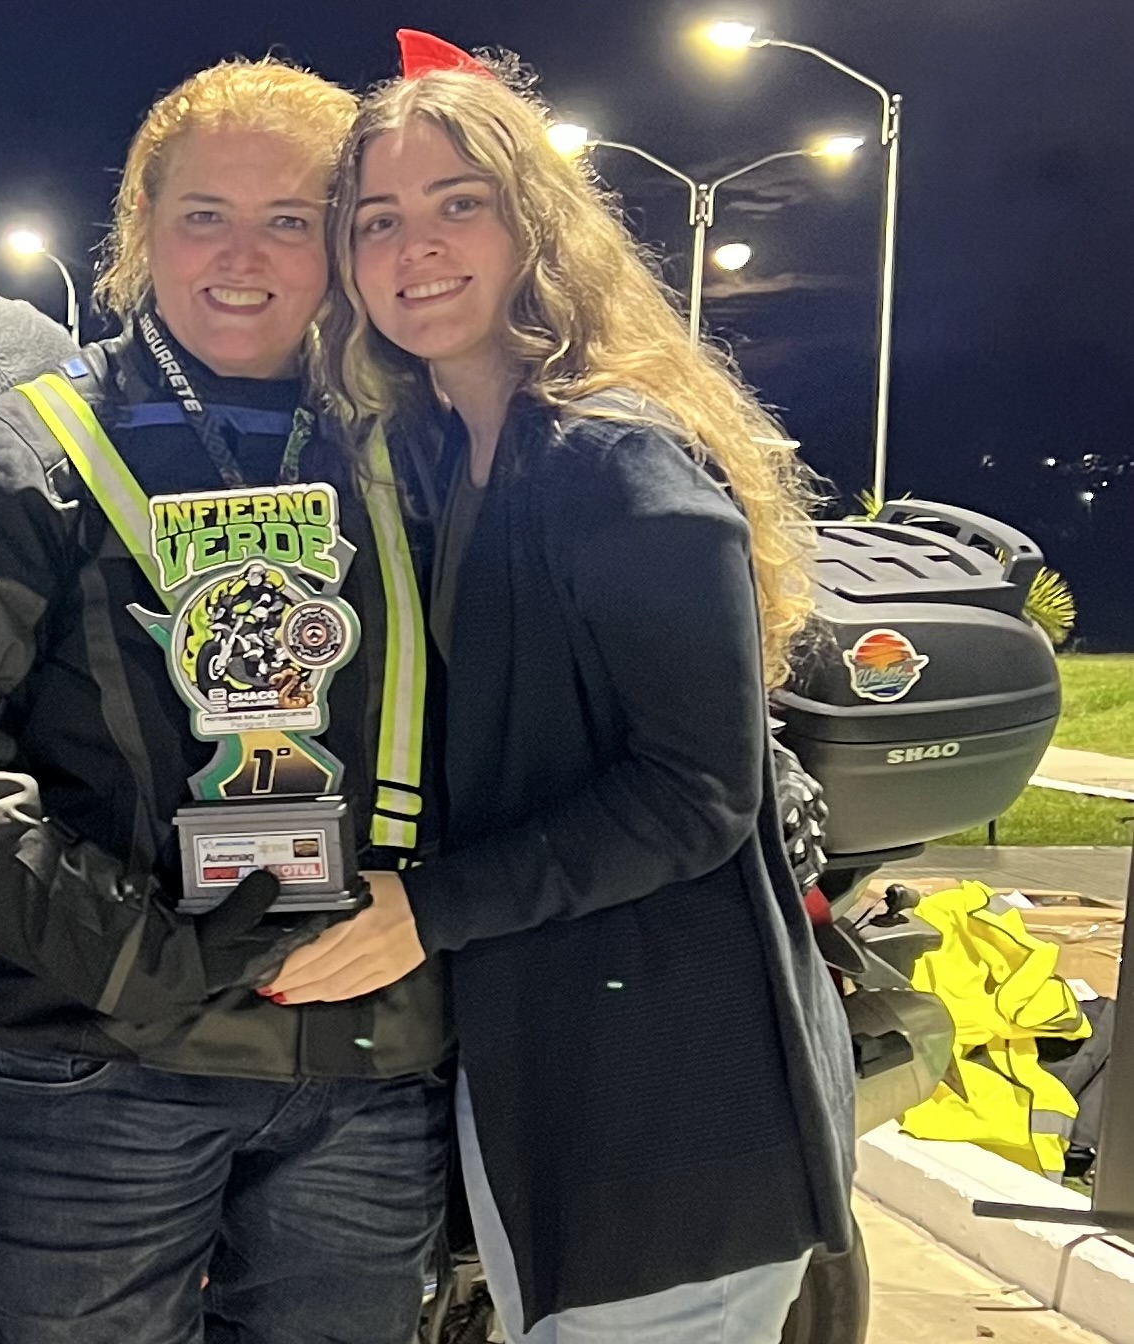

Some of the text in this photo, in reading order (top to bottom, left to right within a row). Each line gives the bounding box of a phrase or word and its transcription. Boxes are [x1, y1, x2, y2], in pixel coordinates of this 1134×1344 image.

[153, 490, 330, 536] INFIERNO
[156, 522, 337, 588] VERDE
[228, 690, 279, 702] CHACO
[886, 742, 961, 764] SH40
